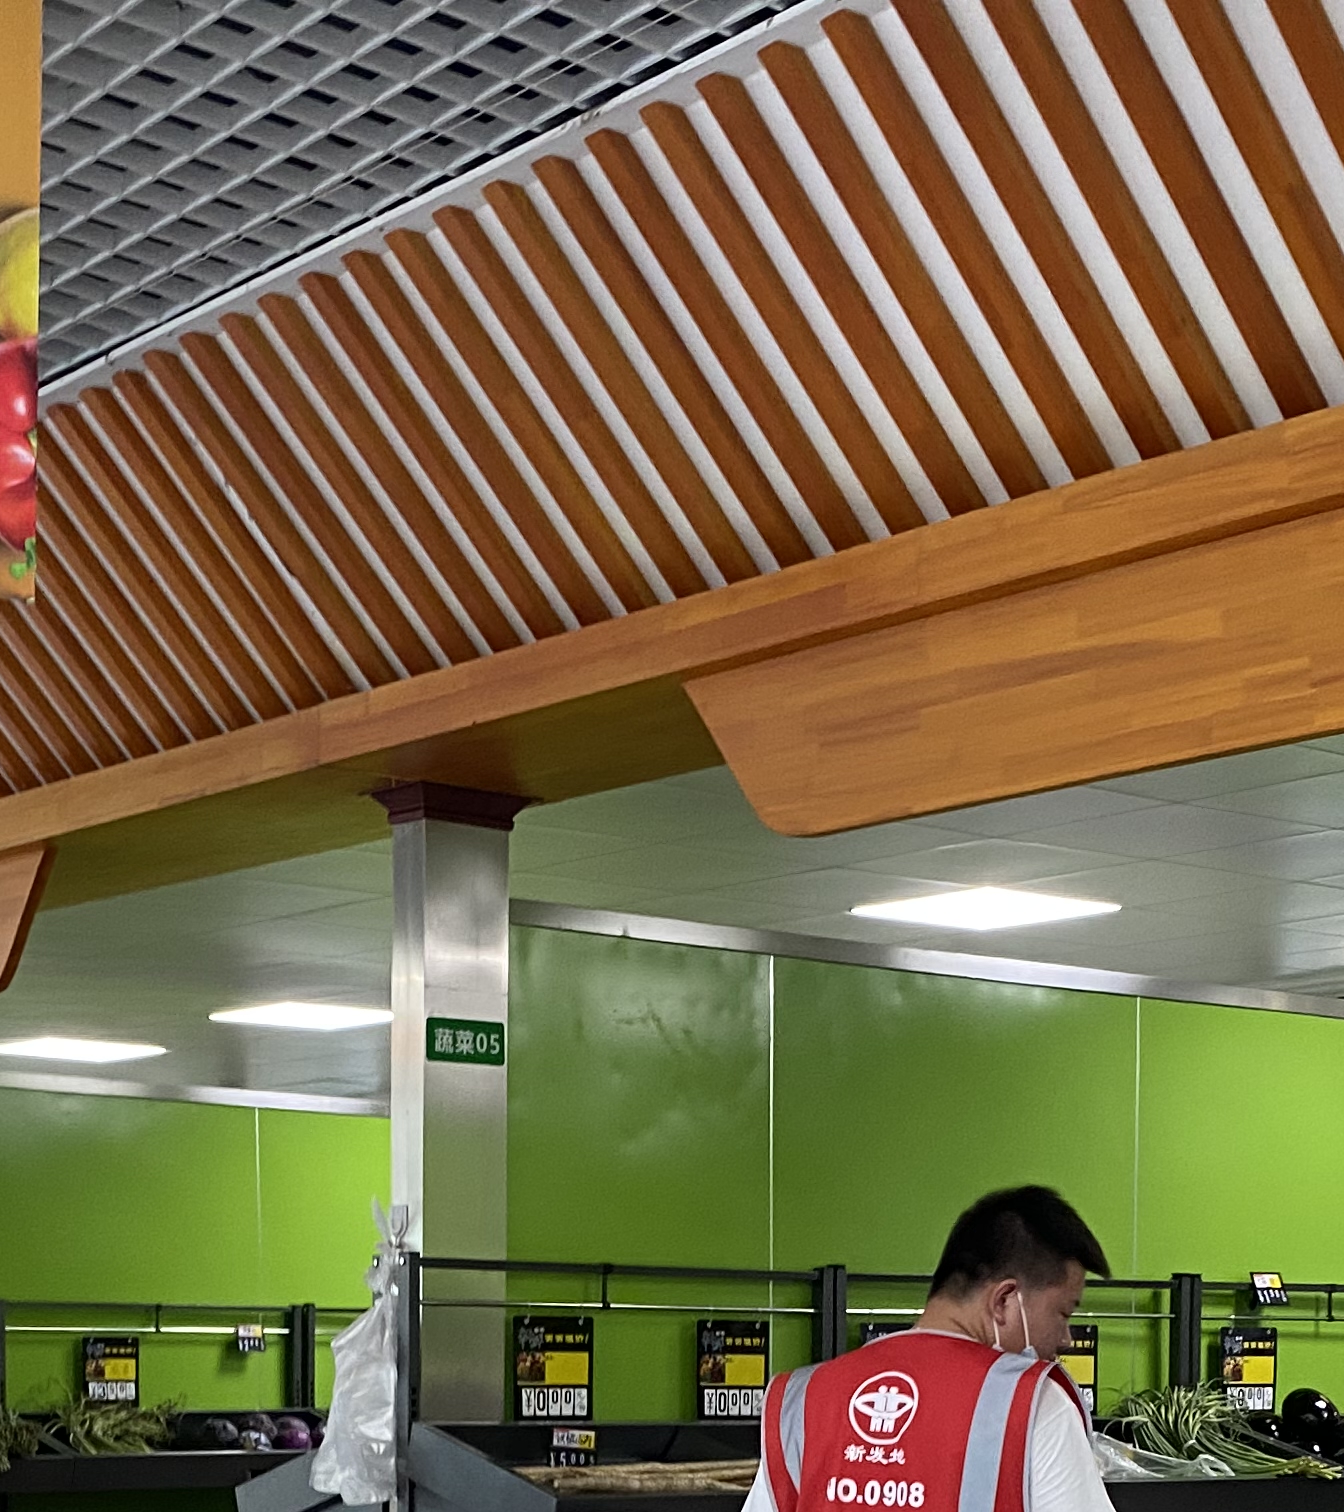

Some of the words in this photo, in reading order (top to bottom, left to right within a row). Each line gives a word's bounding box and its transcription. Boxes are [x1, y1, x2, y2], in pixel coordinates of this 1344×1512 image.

[434, 1027, 500, 1055] 蔬菜05
[844, 1443, 906, 1465] 新发地
